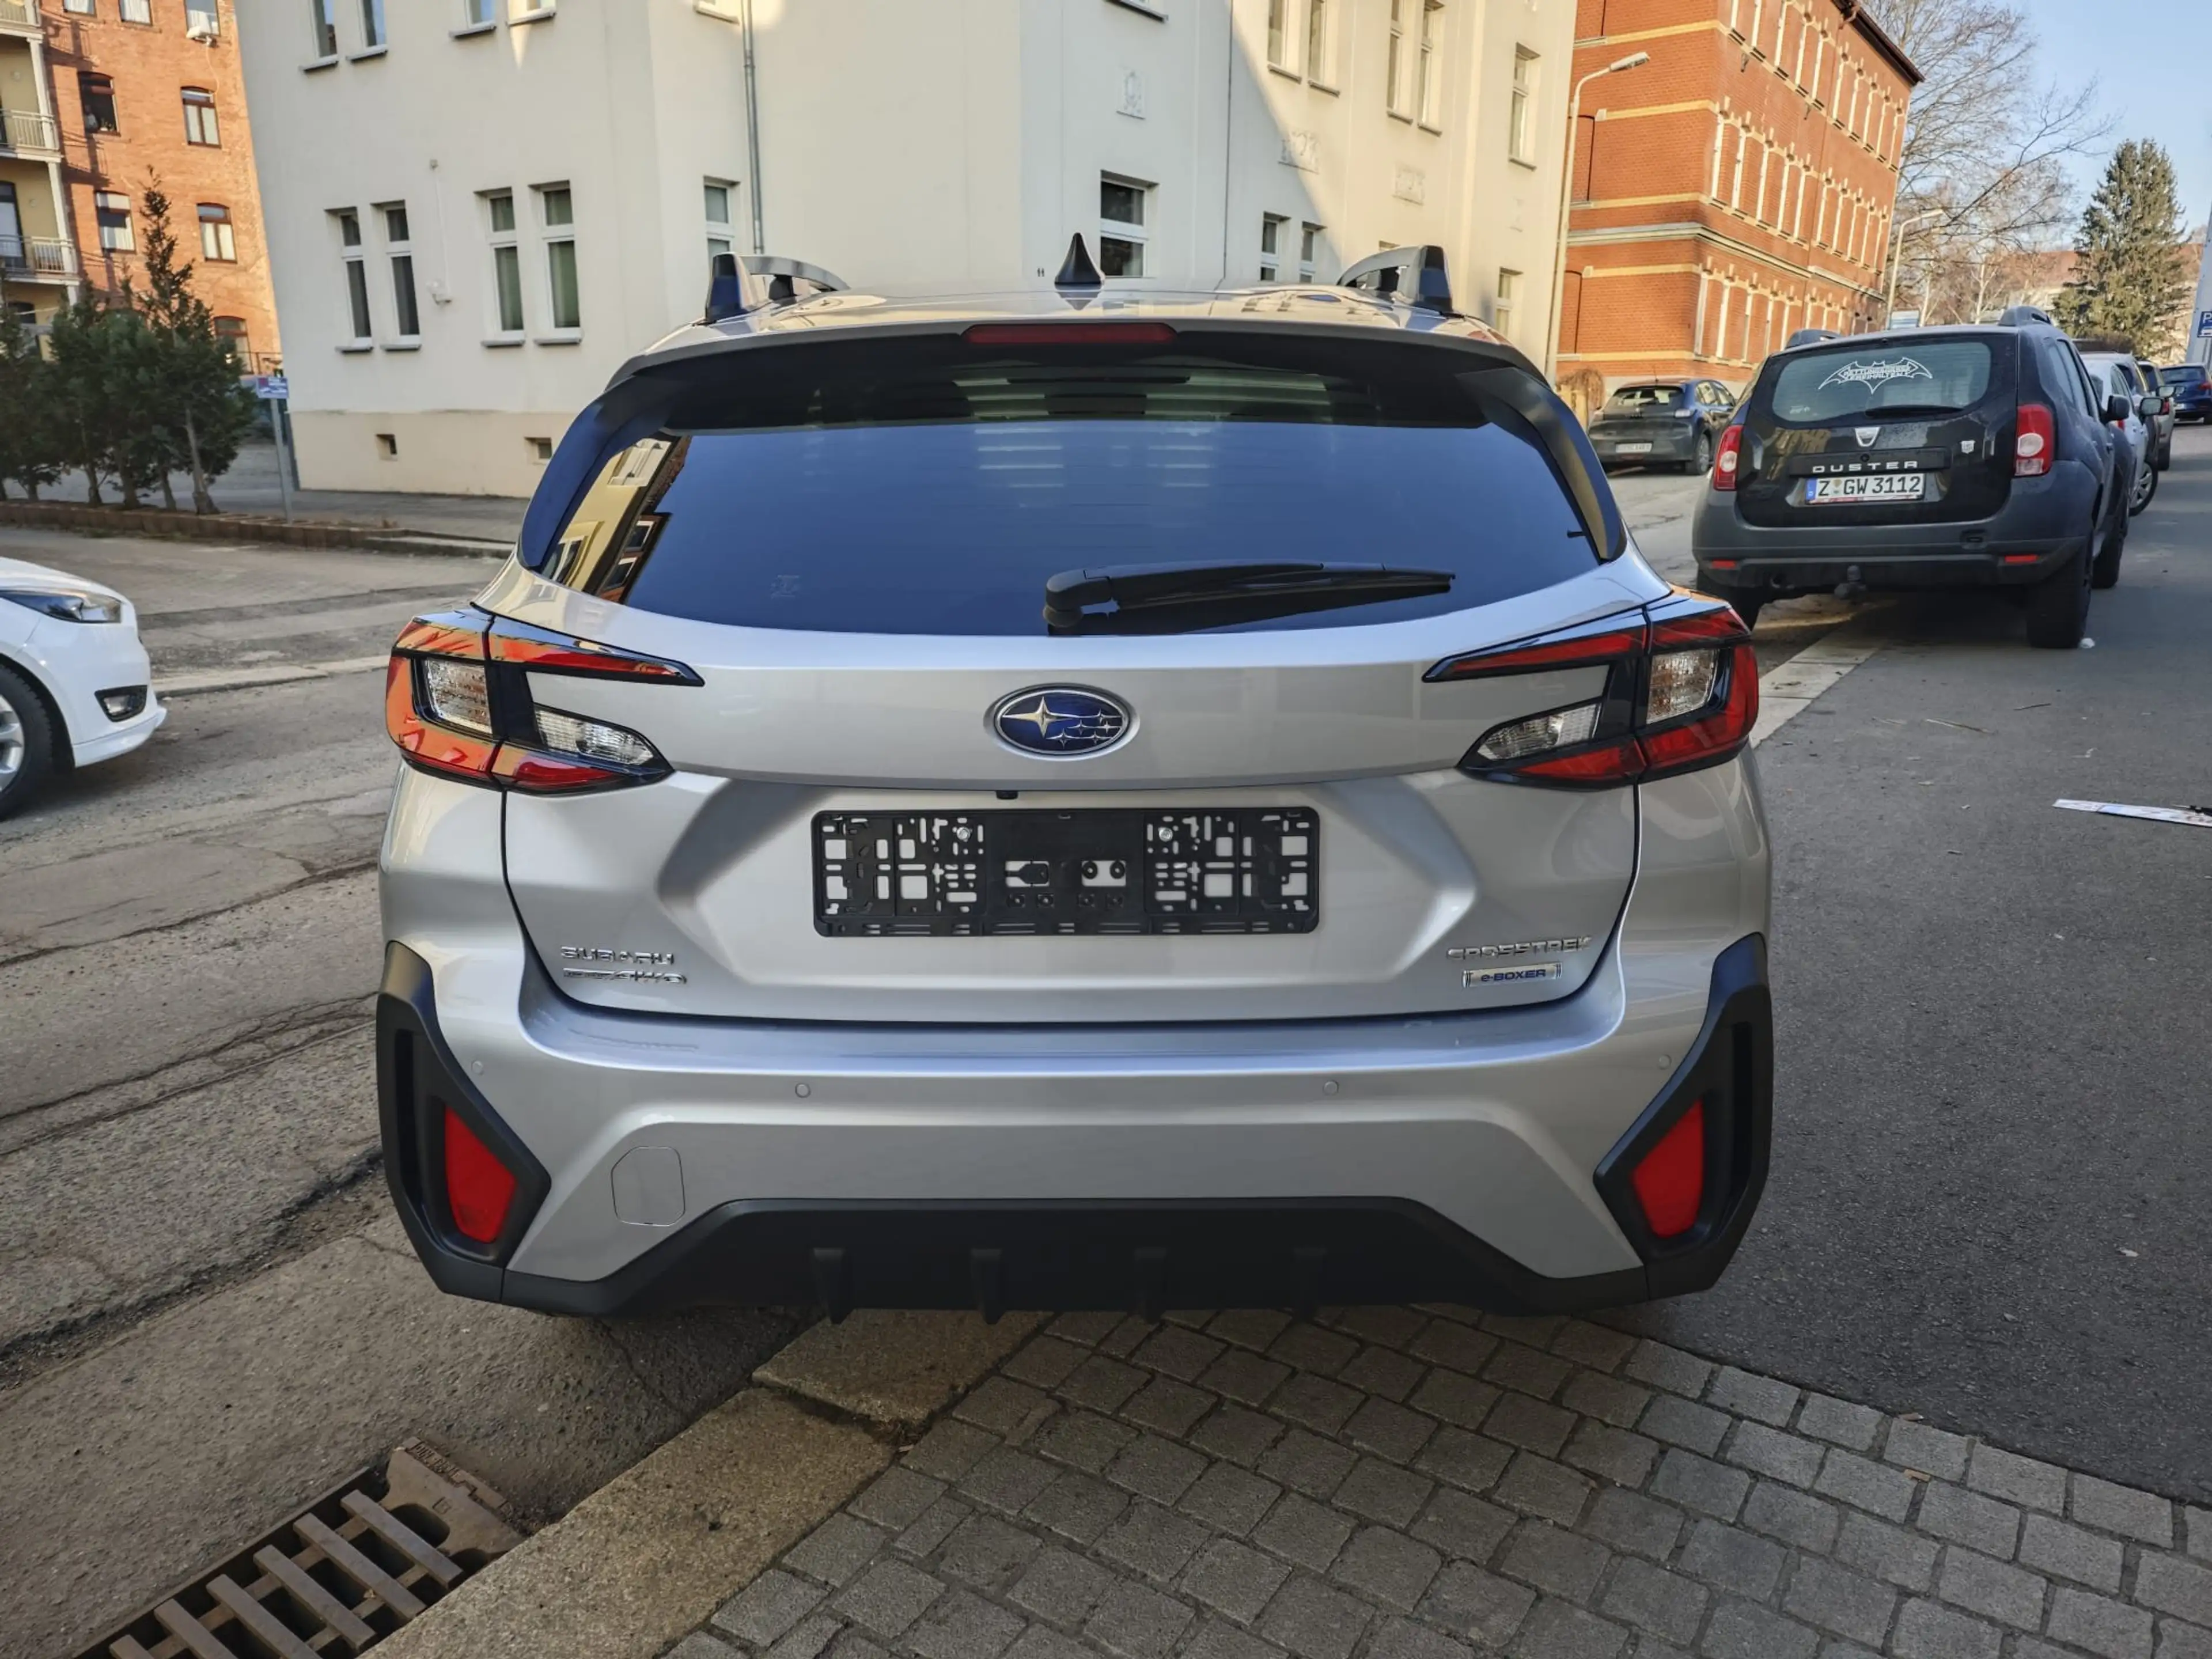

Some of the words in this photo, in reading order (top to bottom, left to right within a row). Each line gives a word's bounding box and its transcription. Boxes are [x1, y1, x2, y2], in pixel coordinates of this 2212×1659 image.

[1812, 461, 1918, 474] DUSTER
[1818, 480, 1830, 496] Z
[1843, 479, 1868, 495] GW
[1872, 476, 1921, 494] 3112
[561, 946, 674, 965] SUBARU
[1446, 935, 1592, 961] CROSSTREK
[1481, 969, 1546, 982] e-BOXER
